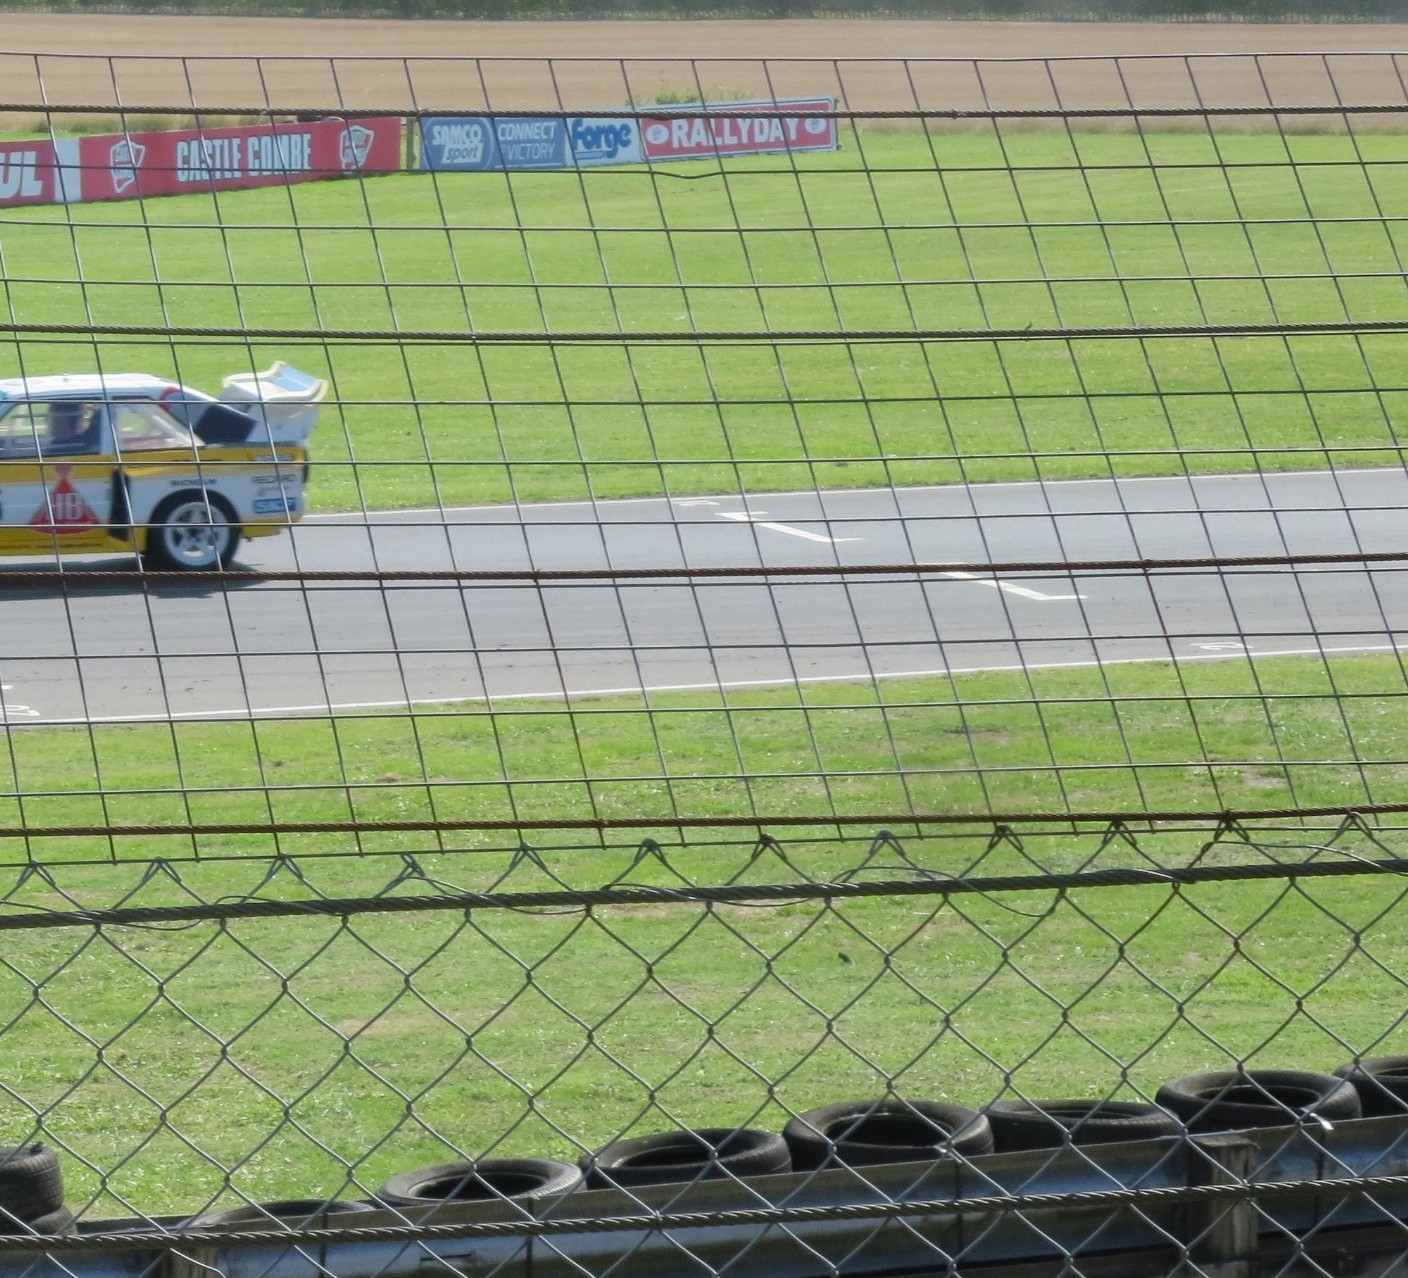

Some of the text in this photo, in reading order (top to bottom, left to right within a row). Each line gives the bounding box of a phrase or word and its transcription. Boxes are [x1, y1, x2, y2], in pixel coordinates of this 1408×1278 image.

[432, 123, 482, 145] SAMCO
[498, 121, 557, 141] CONNECT
[672, 117, 800, 148] RALLYDAY
[177, 138, 242, 182] CASTLE
[247, 133, 312, 176] COMBE
[506, 142, 556, 160] VICTORY
